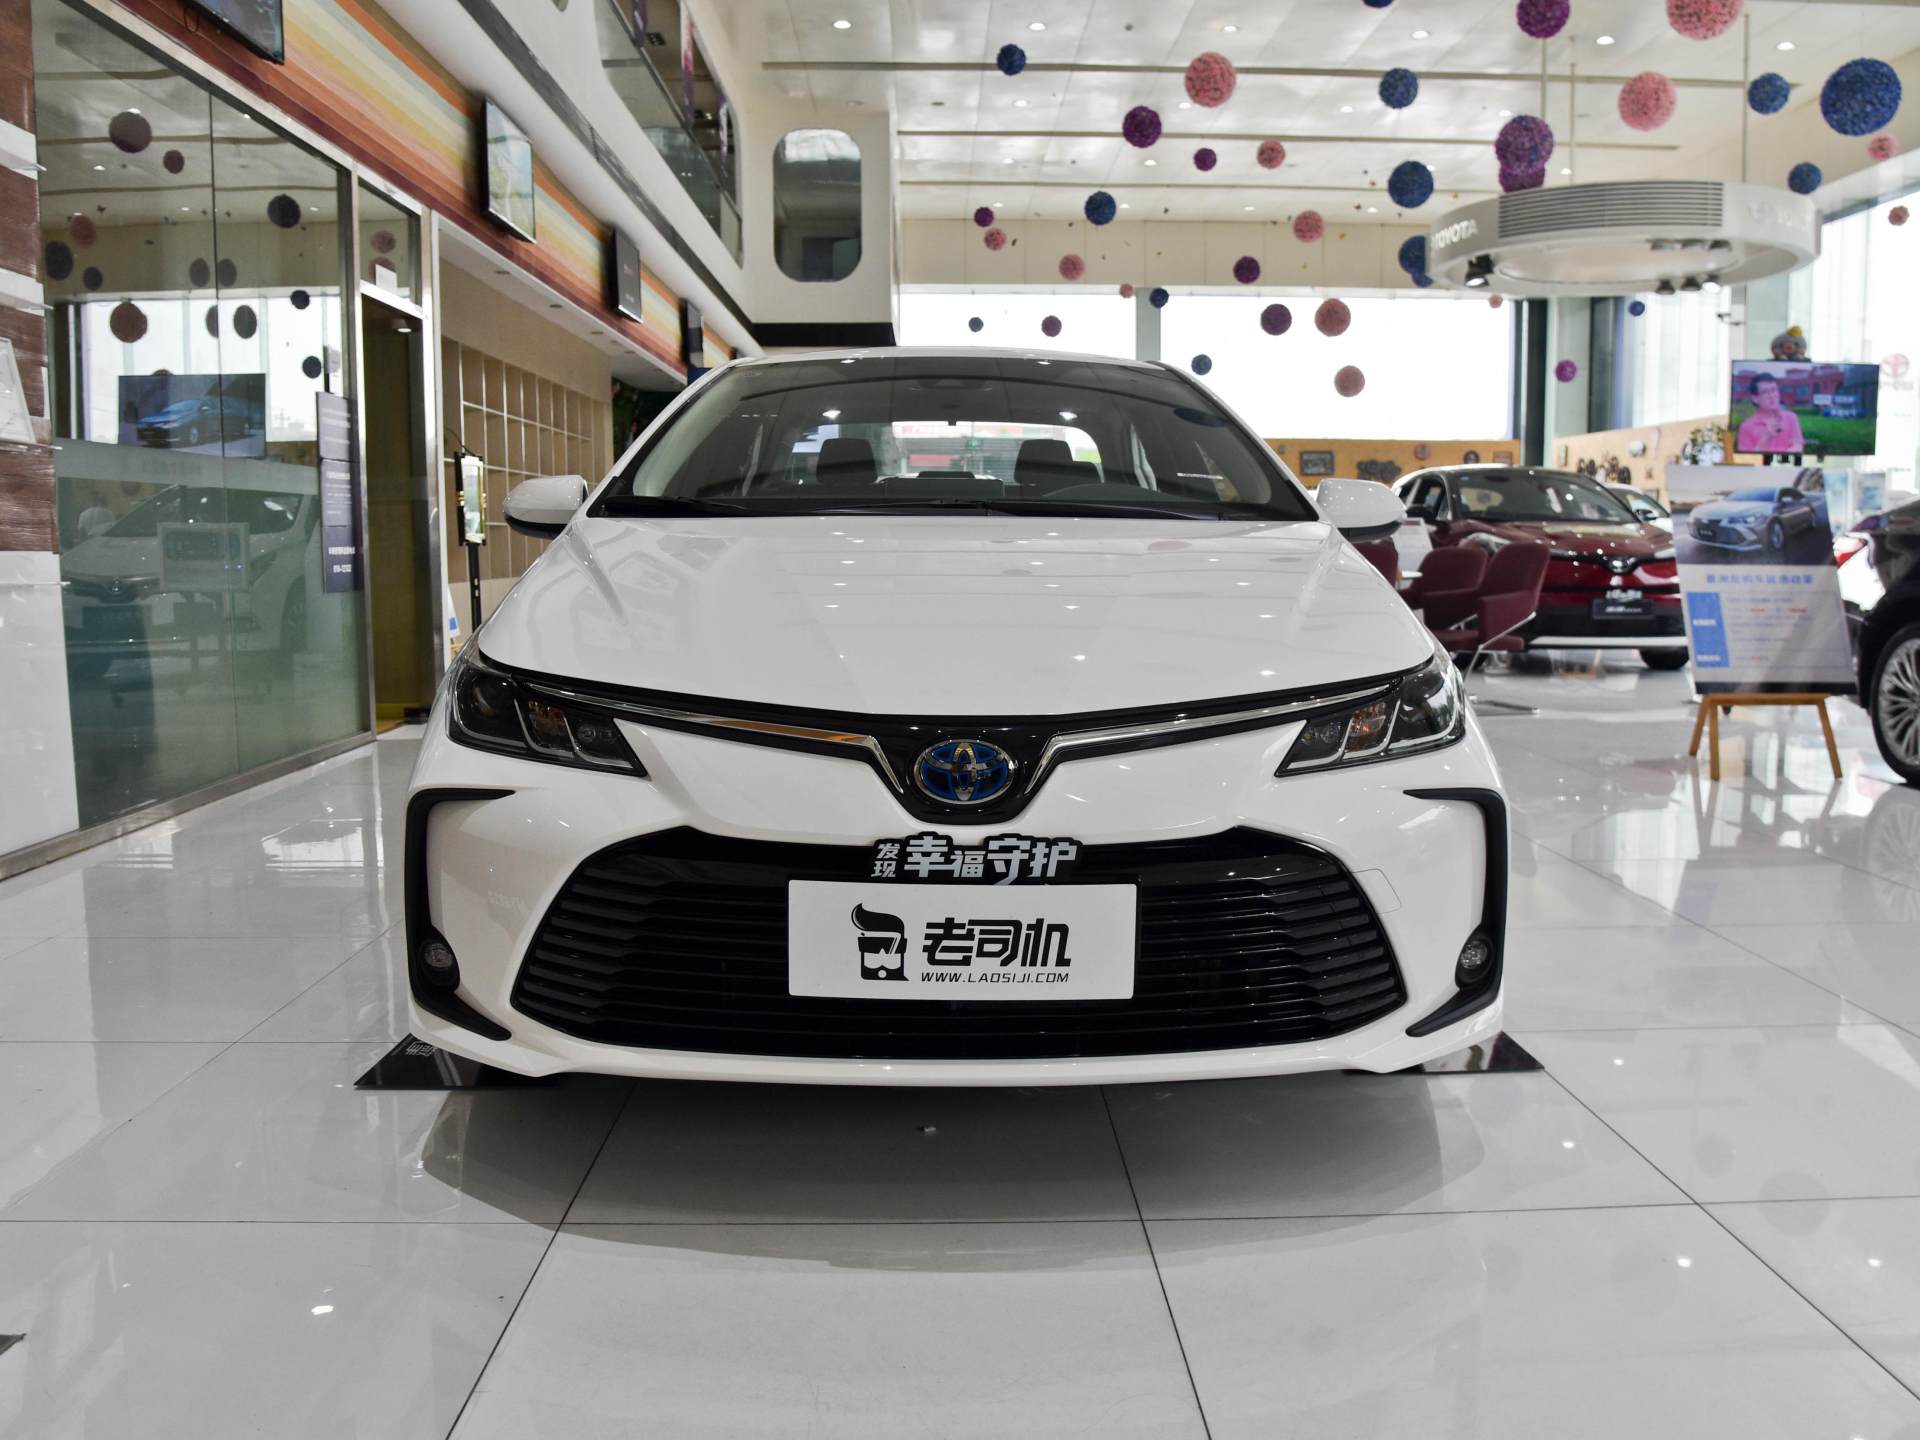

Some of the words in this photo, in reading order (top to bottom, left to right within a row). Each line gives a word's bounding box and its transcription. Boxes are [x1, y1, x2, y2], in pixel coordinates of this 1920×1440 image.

[904, 836, 1077, 885] 幸福守护
[922, 917, 1071, 968] 老司机
[921, 972, 1069, 983] WWW.LAOSIJI.COM
